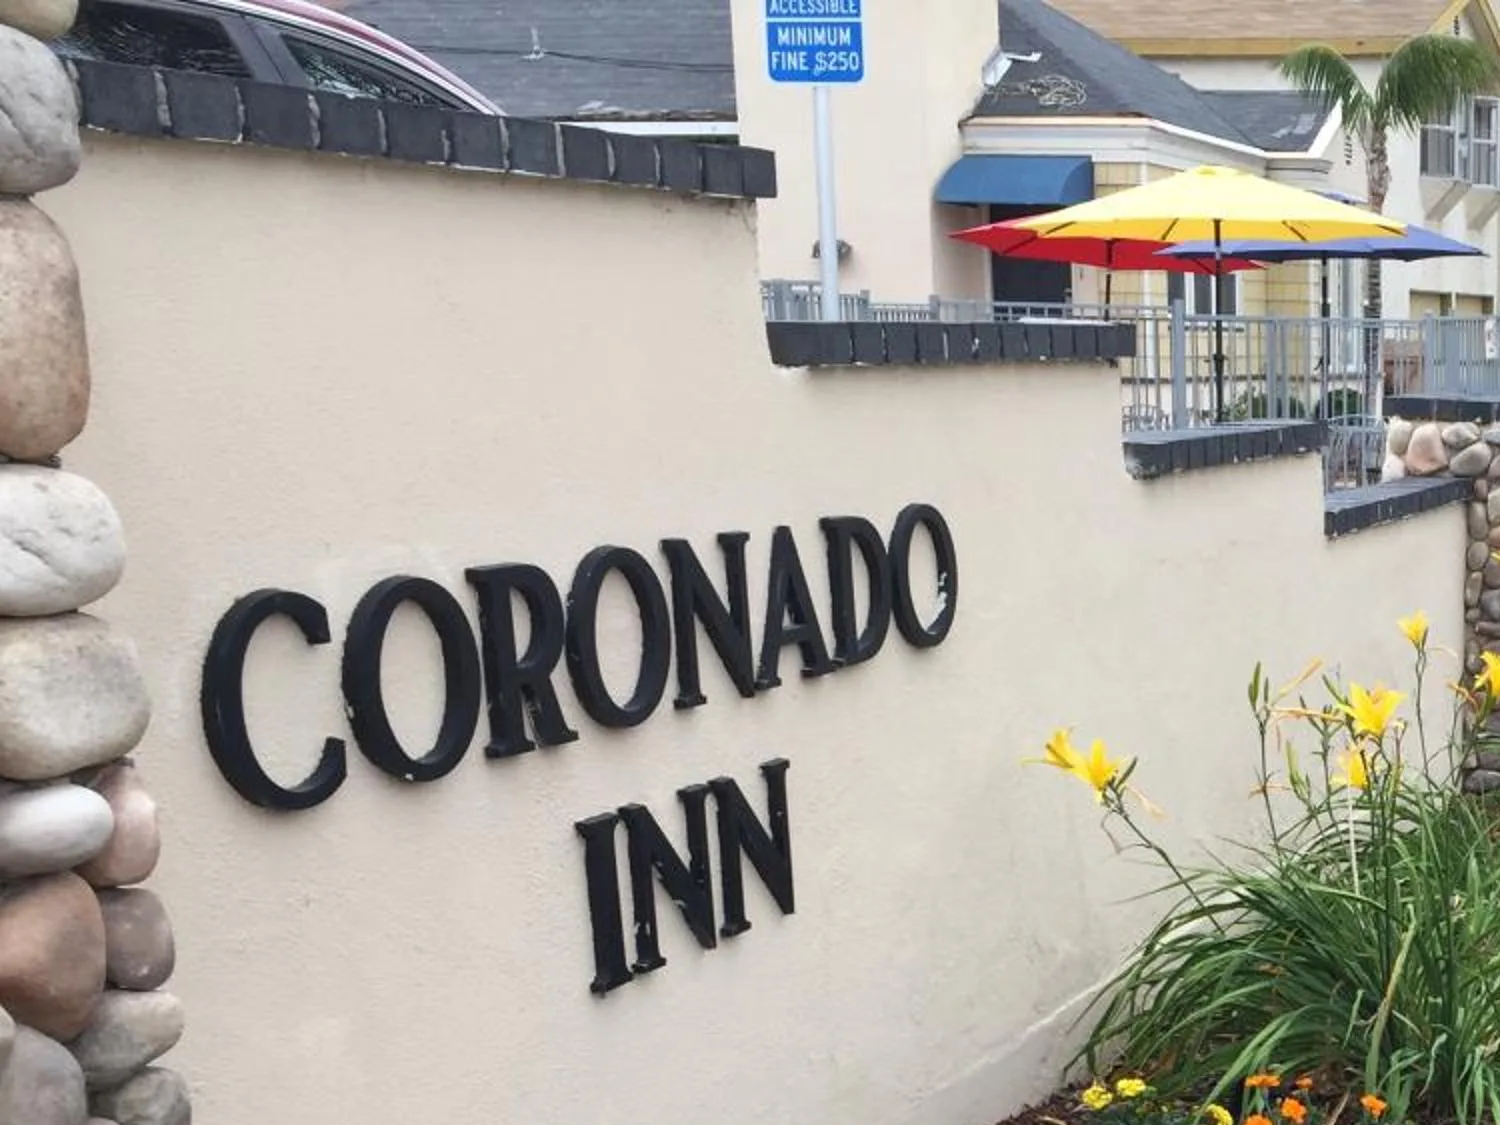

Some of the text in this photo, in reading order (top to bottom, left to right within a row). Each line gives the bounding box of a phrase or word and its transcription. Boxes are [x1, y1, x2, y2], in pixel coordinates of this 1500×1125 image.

[771, 51, 859, 71] FINE $250
[777, 26, 851, 46] MINIMUM
[201, 503, 957, 812] CORONADO
[573, 757, 795, 995] INN
